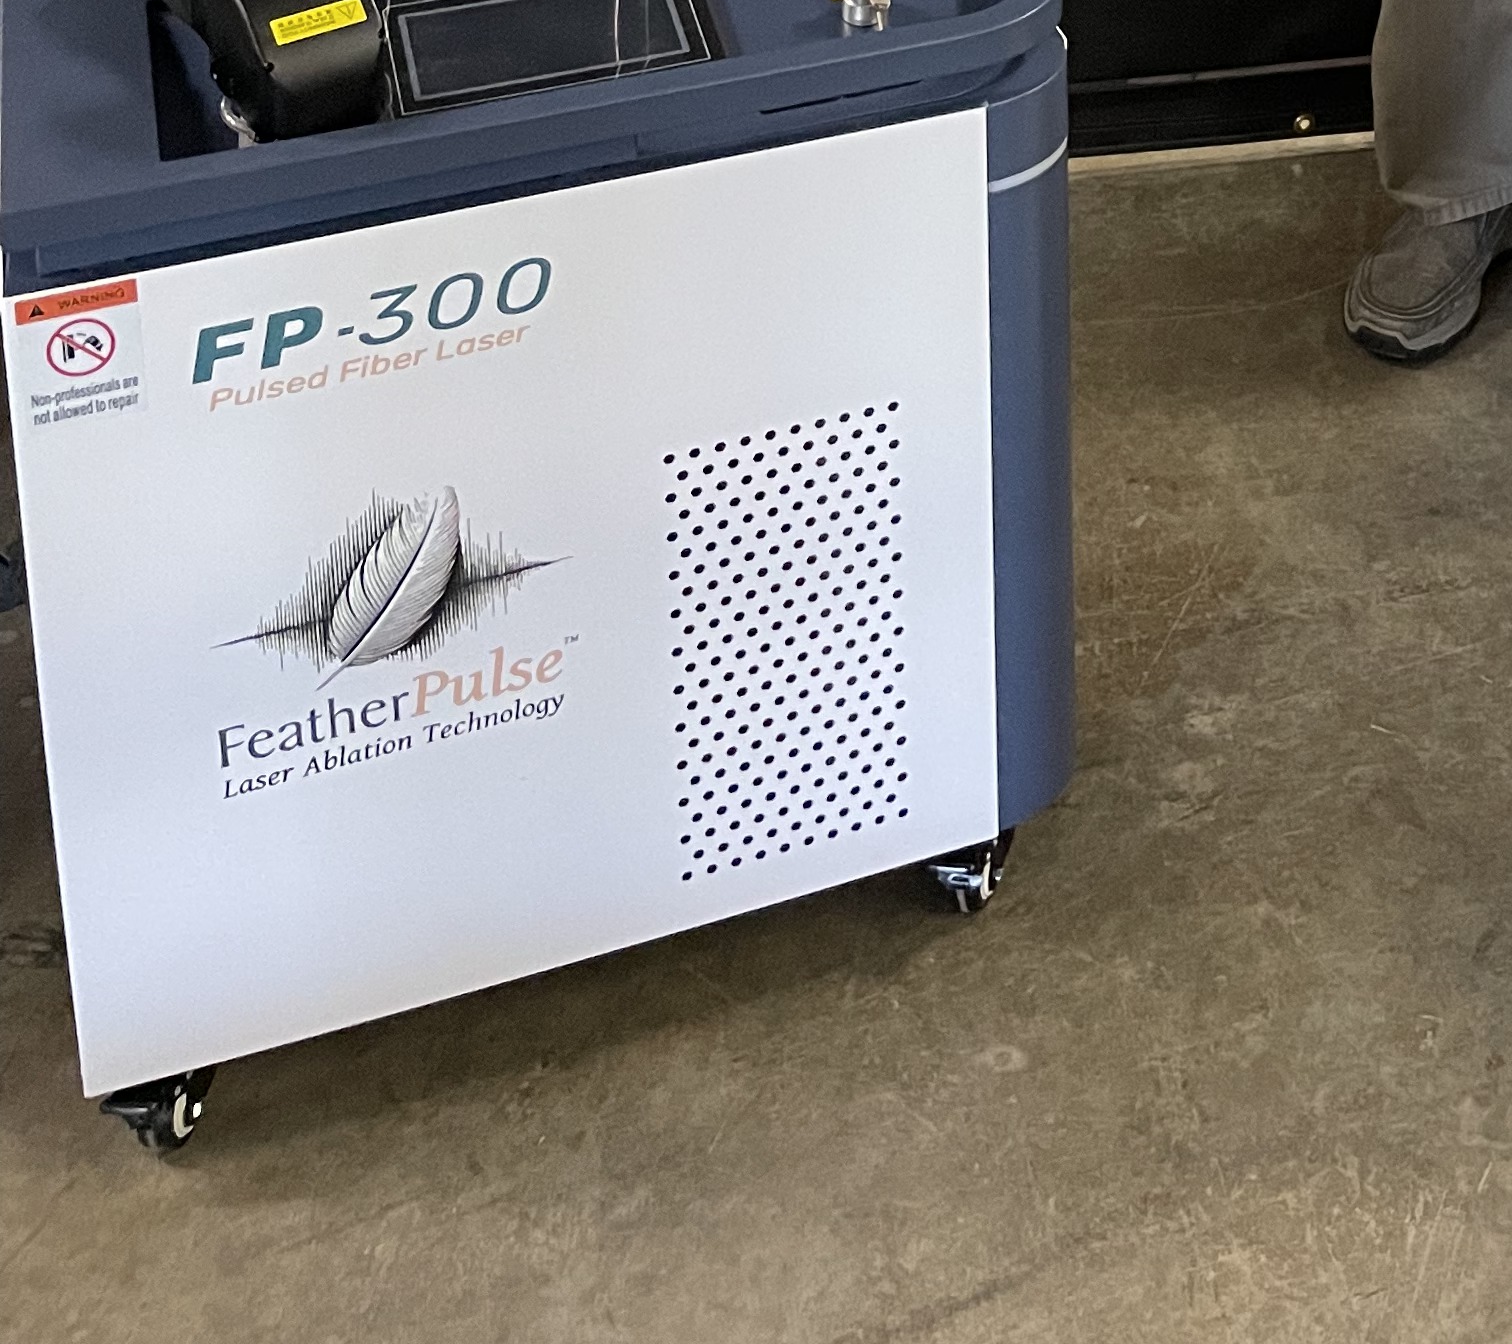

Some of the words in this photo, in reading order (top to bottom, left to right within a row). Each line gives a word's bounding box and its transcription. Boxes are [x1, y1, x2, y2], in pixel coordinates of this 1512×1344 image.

[57, 287, 125, 310] WARNING
[191, 256, 552, 385] FP-300
[31, 377, 121, 408] Non-professionals
[122, 376, 138, 387] are
[209, 364, 329, 413] Pulsed
[339, 347, 428, 383] Fiber
[435, 324, 531, 361] Laser
[33, 409, 51, 426] not
[53, 402, 94, 423] allowed
[95, 398, 107, 412] to
[108, 392, 139, 411] repair
[223, 764, 294, 800] Laser
[303, 734, 413, 778] Ablation
[423, 693, 566, 745] Technology
